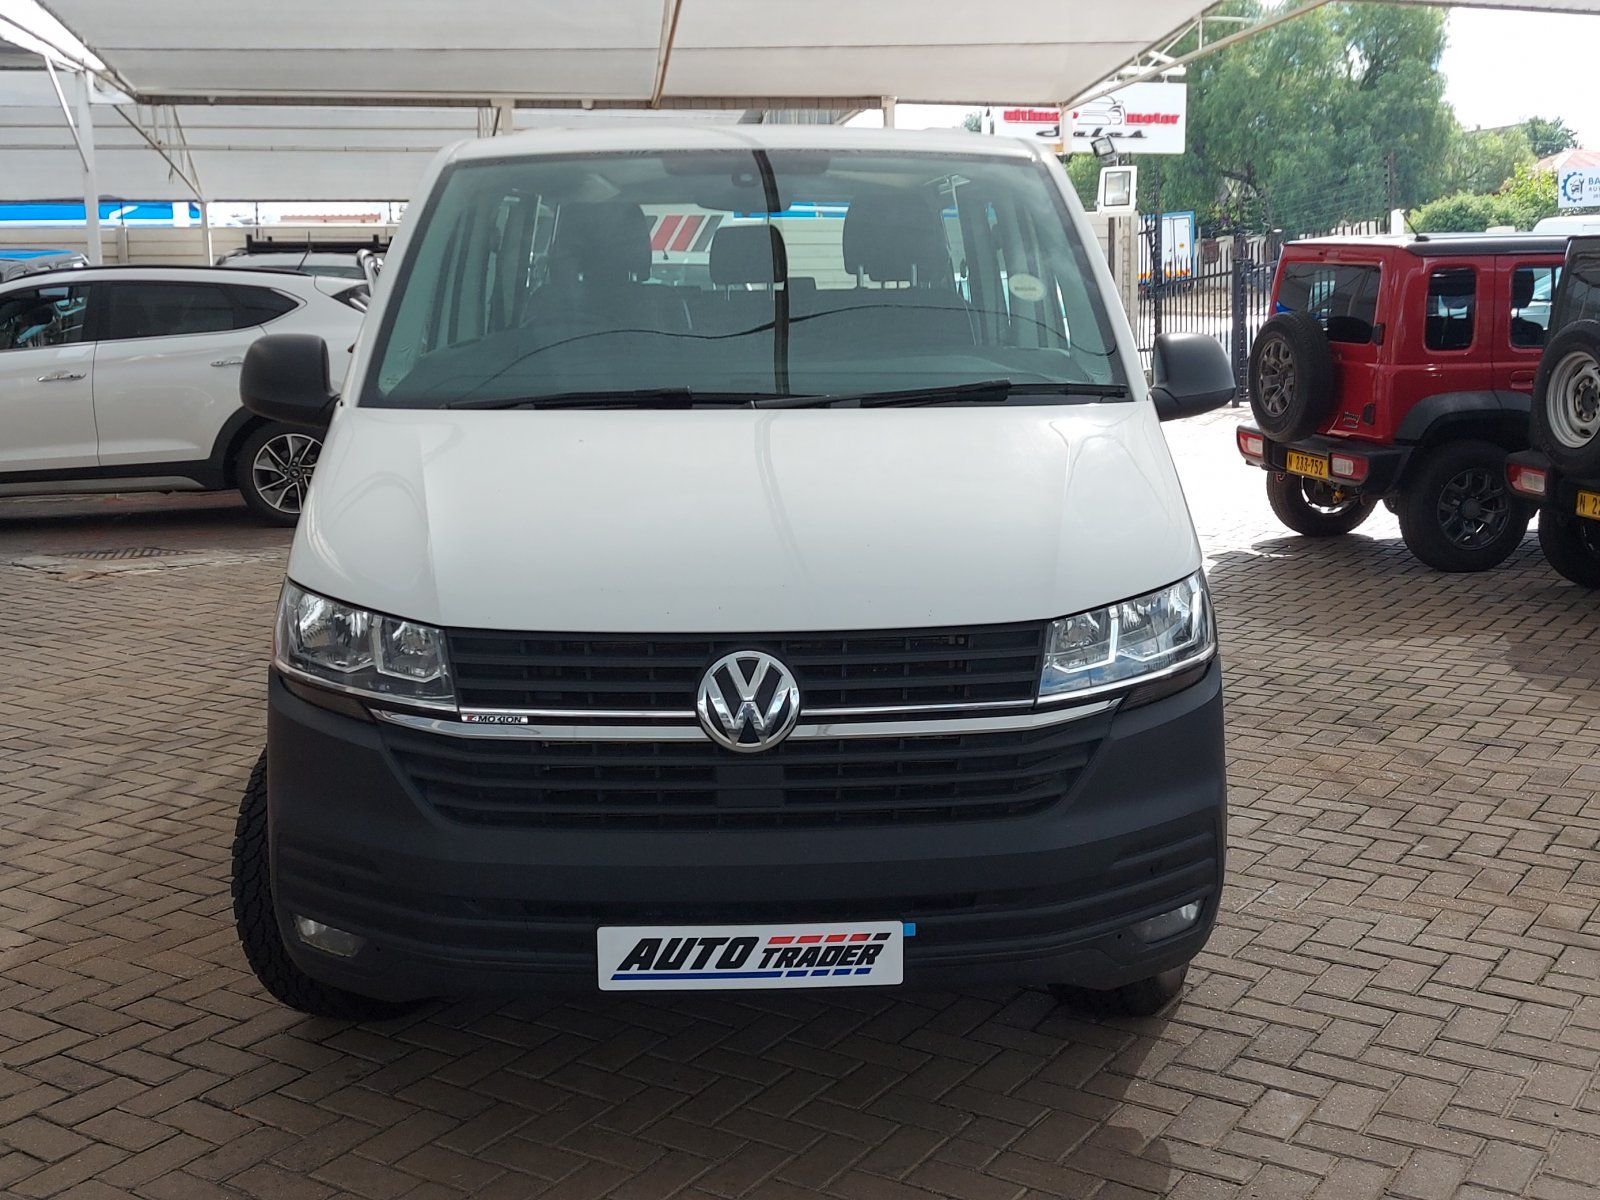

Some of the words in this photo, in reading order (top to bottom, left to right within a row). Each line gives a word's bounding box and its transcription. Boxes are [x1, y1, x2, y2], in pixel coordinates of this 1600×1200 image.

[1295, 455, 1324, 476] 233-752
[1591, 497, 1600, 516] 2
[616, 936, 760, 971] AUTO
[757, 943, 885, 970] TRADER
